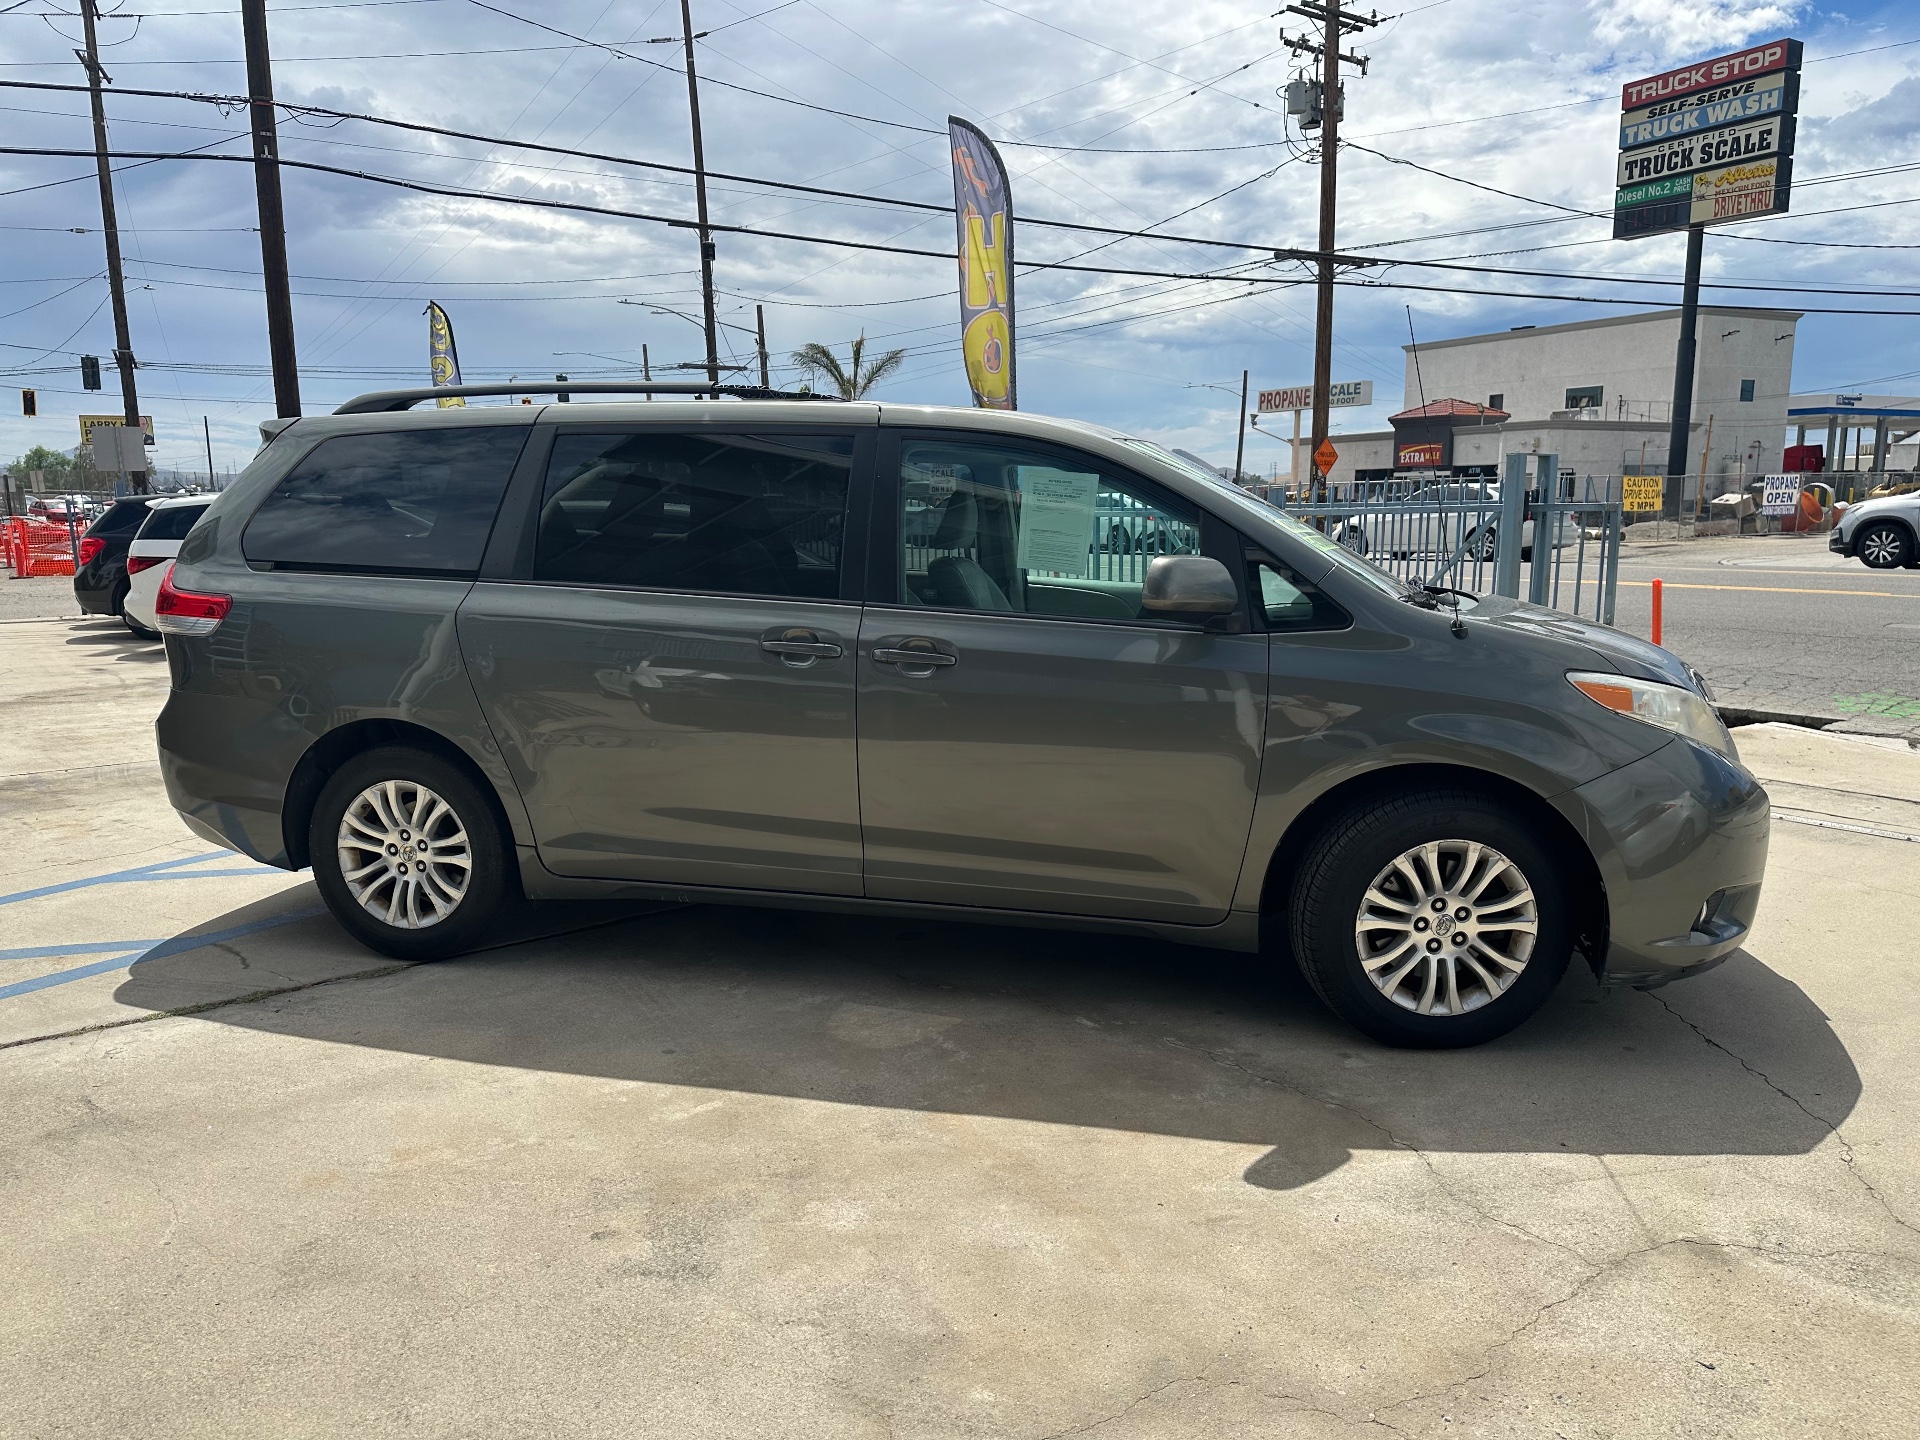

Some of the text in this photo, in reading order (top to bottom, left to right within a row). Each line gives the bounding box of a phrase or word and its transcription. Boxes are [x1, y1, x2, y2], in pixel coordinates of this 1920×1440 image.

[1628, 47, 1781, 102] TRUCK STOP
[1647, 82, 1755, 118] SELF-SERVE
[1626, 90, 1779, 144] TRUCK WASH
[1658, 129, 1736, 152] CERTIFIED
[1625, 128, 1772, 180] TRUCK SCALE
[1675, 176, 1691, 186] CASH
[1751, 180, 1771, 189] FOOD
[1617, 182, 1671, 204] Diesel No.2
[1673, 184, 1691, 194] PRICE
[1260, 382, 1361, 410] PROPANE CALE
[1336, 397, 1356, 405] FOOT
[1400, 452, 1425, 463] EXTRA
[930, 469, 955, 478] SCALE
[1627, 478, 1660, 488] CAUTION
[1765, 476, 1798, 490] PROPANE
[1624, 489, 1662, 500] DRIVE SLOW
[1766, 491, 1794, 504] OPEN
[1630, 501, 1655, 510] 5 MPH
